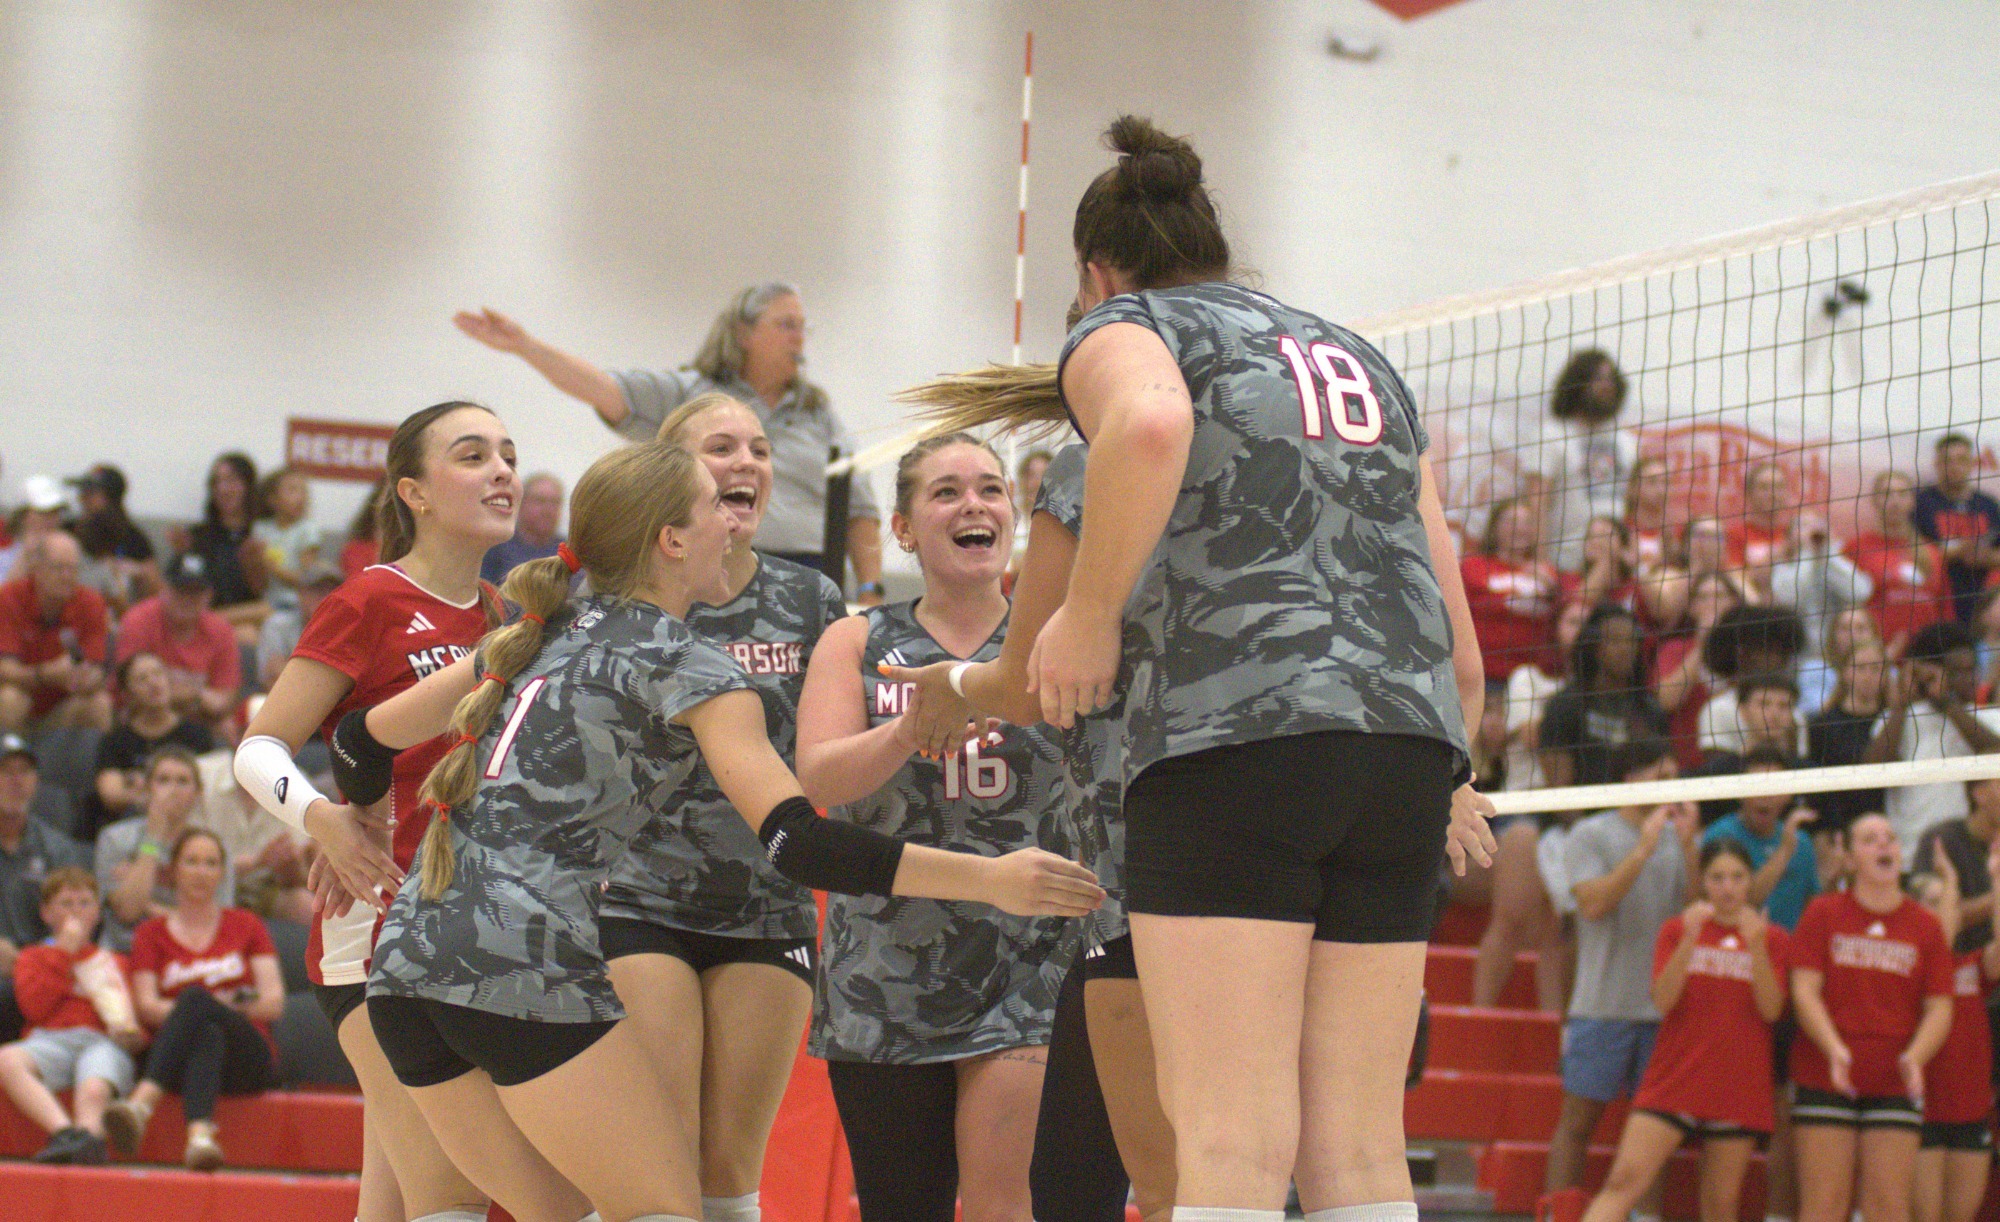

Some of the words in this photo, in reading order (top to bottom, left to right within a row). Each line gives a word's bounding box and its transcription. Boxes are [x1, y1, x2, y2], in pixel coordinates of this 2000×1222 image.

[1278, 334, 1384, 447] 18
[725, 642, 803, 675] RSON
[484, 675, 547, 780] 1
[944, 731, 1010, 800] 16
